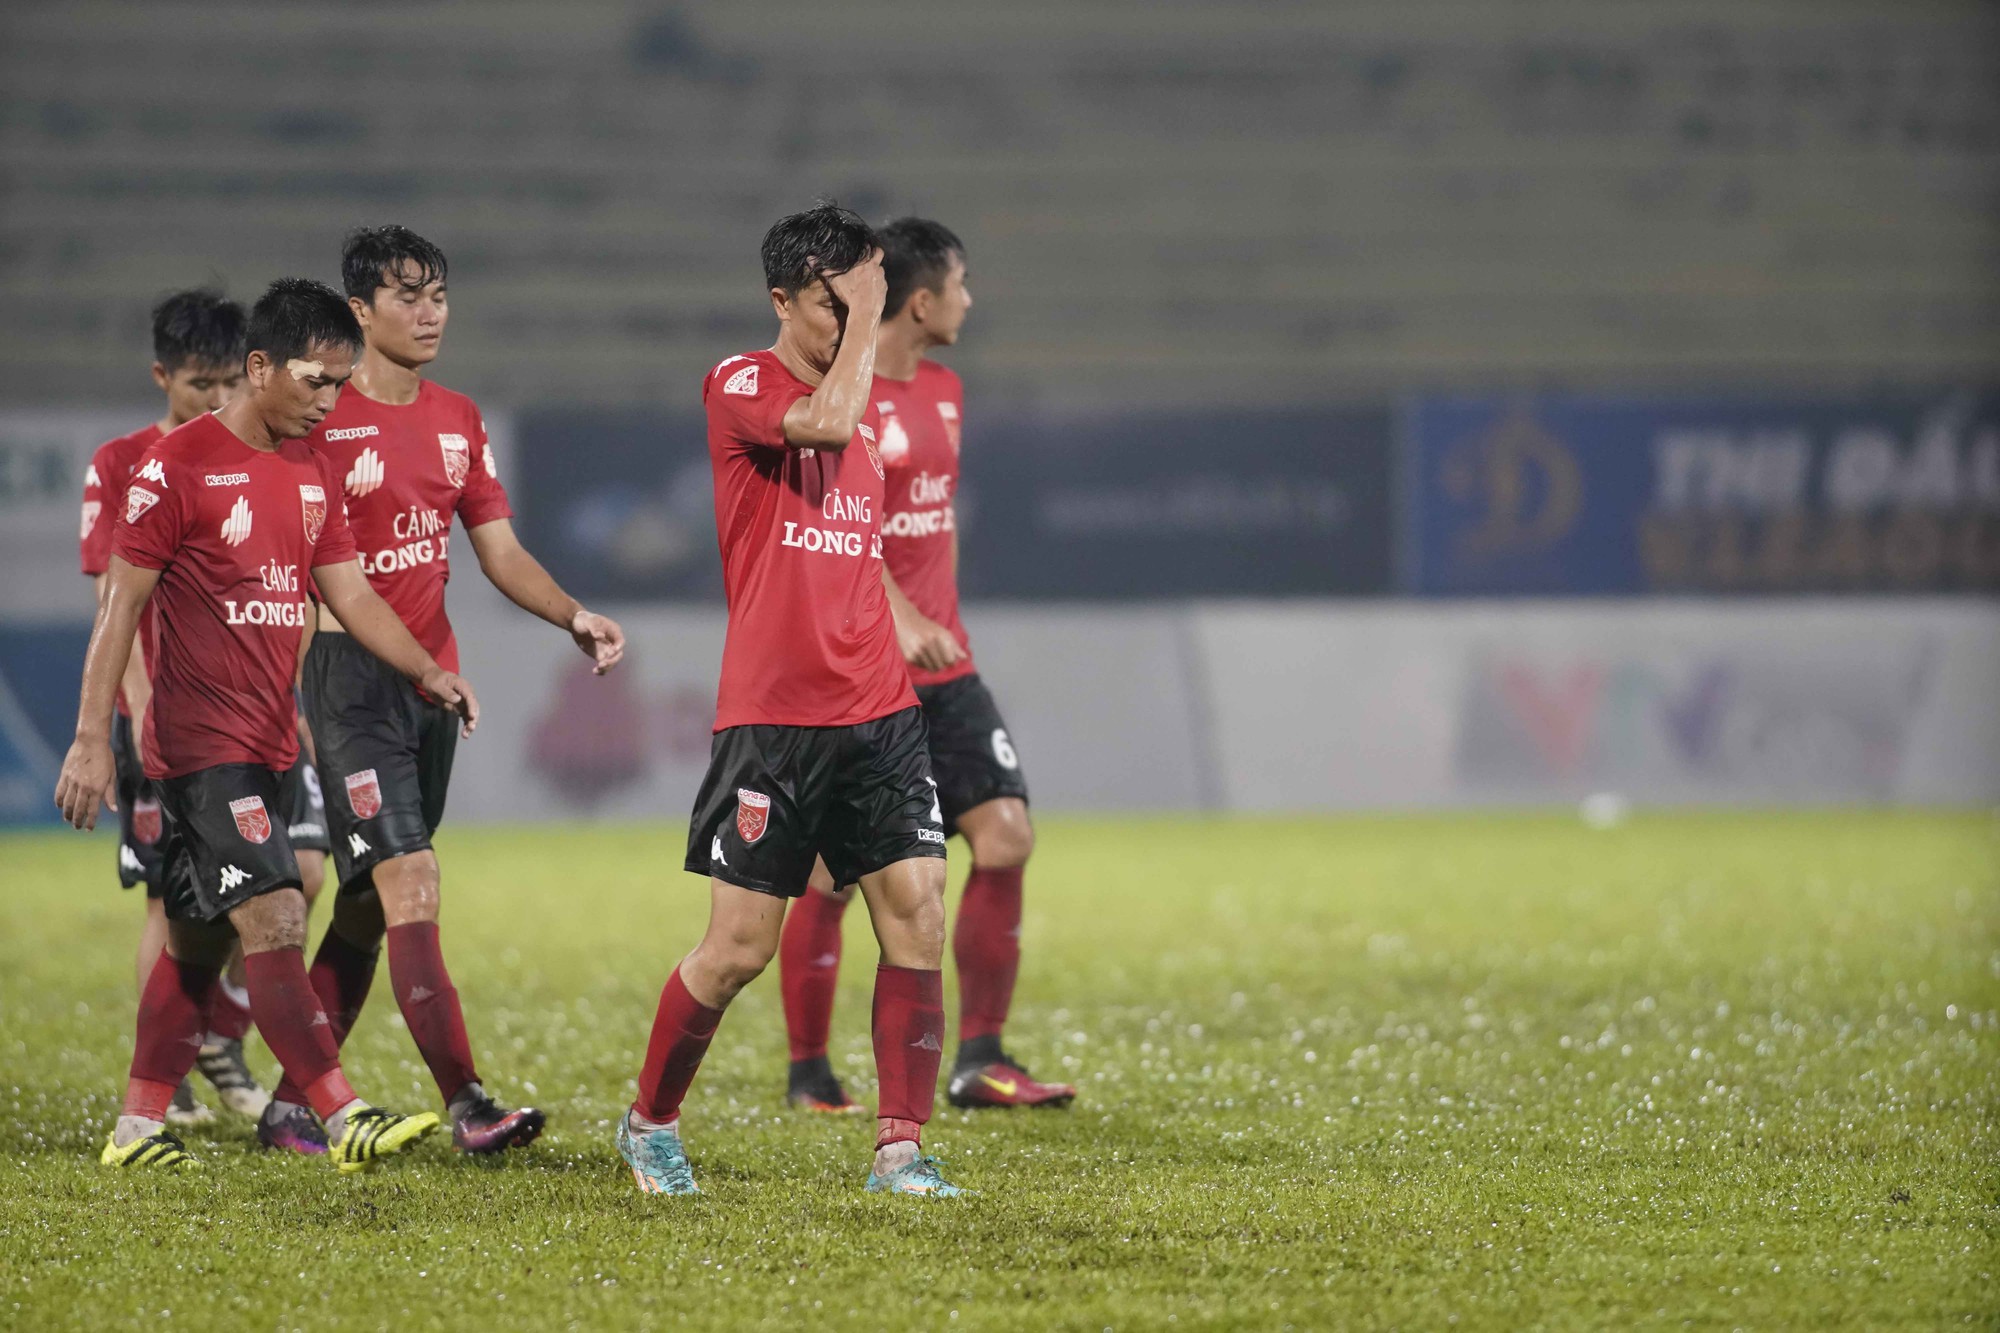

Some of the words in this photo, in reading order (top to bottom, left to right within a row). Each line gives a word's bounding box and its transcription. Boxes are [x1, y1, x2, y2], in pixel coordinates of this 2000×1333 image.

[326, 426, 380, 441] Kappa
[129, 488, 154, 504] OYOTA
[206, 473, 251, 487] Kappa
[823, 488, 871, 524] CẢNG
[781, 521, 863, 557] LONG
[357, 539, 434, 574] LONG
[260, 558, 298, 592] CẢNG
[225, 601, 295, 627] LONG
[991, 728, 1018, 770] 6
[303, 764, 325, 811] 9
[739, 789, 759, 801] LONG
